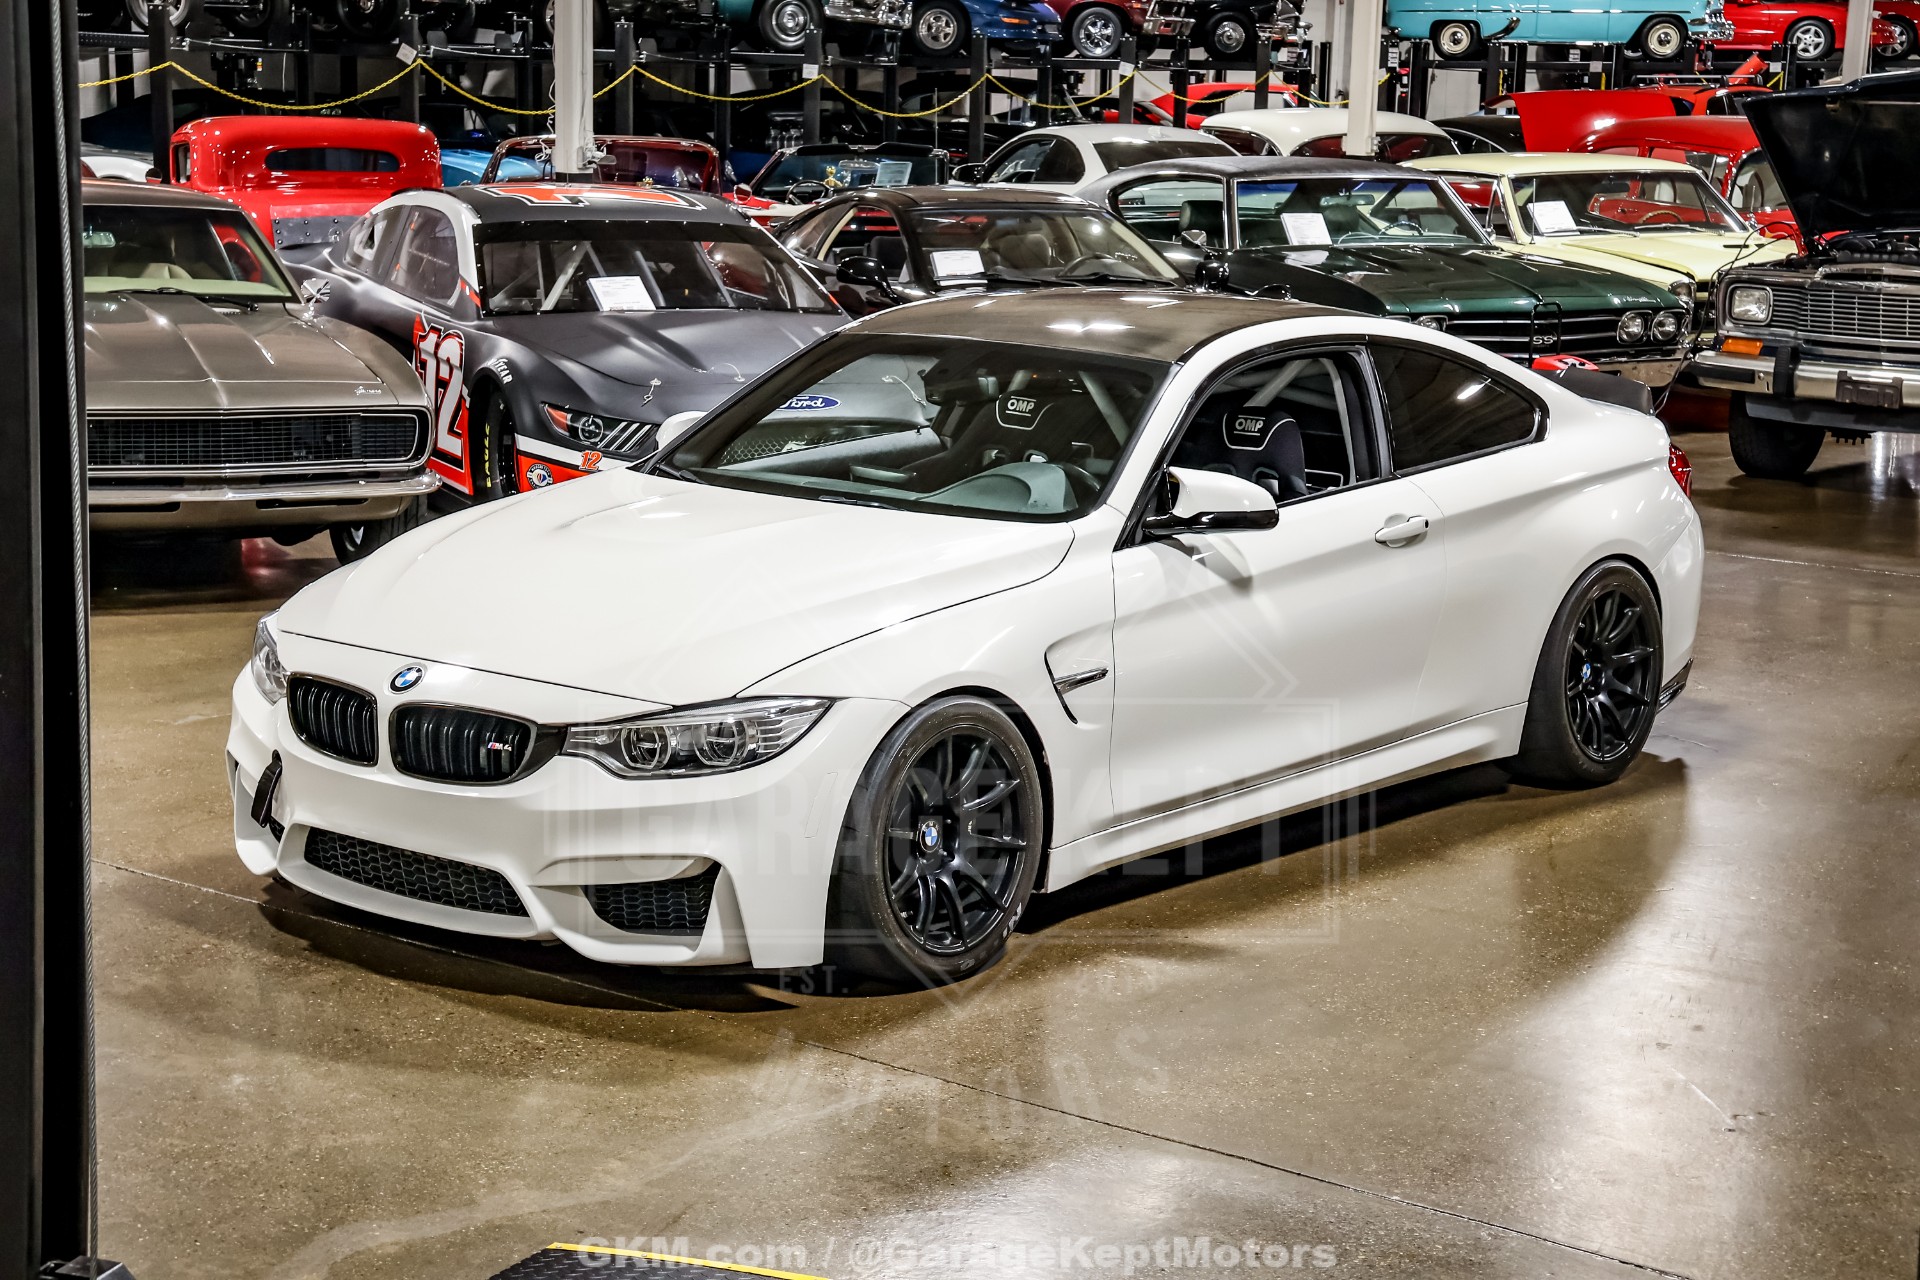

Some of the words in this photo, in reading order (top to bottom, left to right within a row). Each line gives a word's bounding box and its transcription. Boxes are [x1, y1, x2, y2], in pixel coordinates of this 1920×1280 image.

[1533, 335, 1554, 345] SS
[416, 323, 465, 472] 12
[780, 396, 826, 407] Ford
[1007, 399, 1035, 412] OMP
[1235, 418, 1264, 431] OMP
[580, 450, 602, 470] 12
